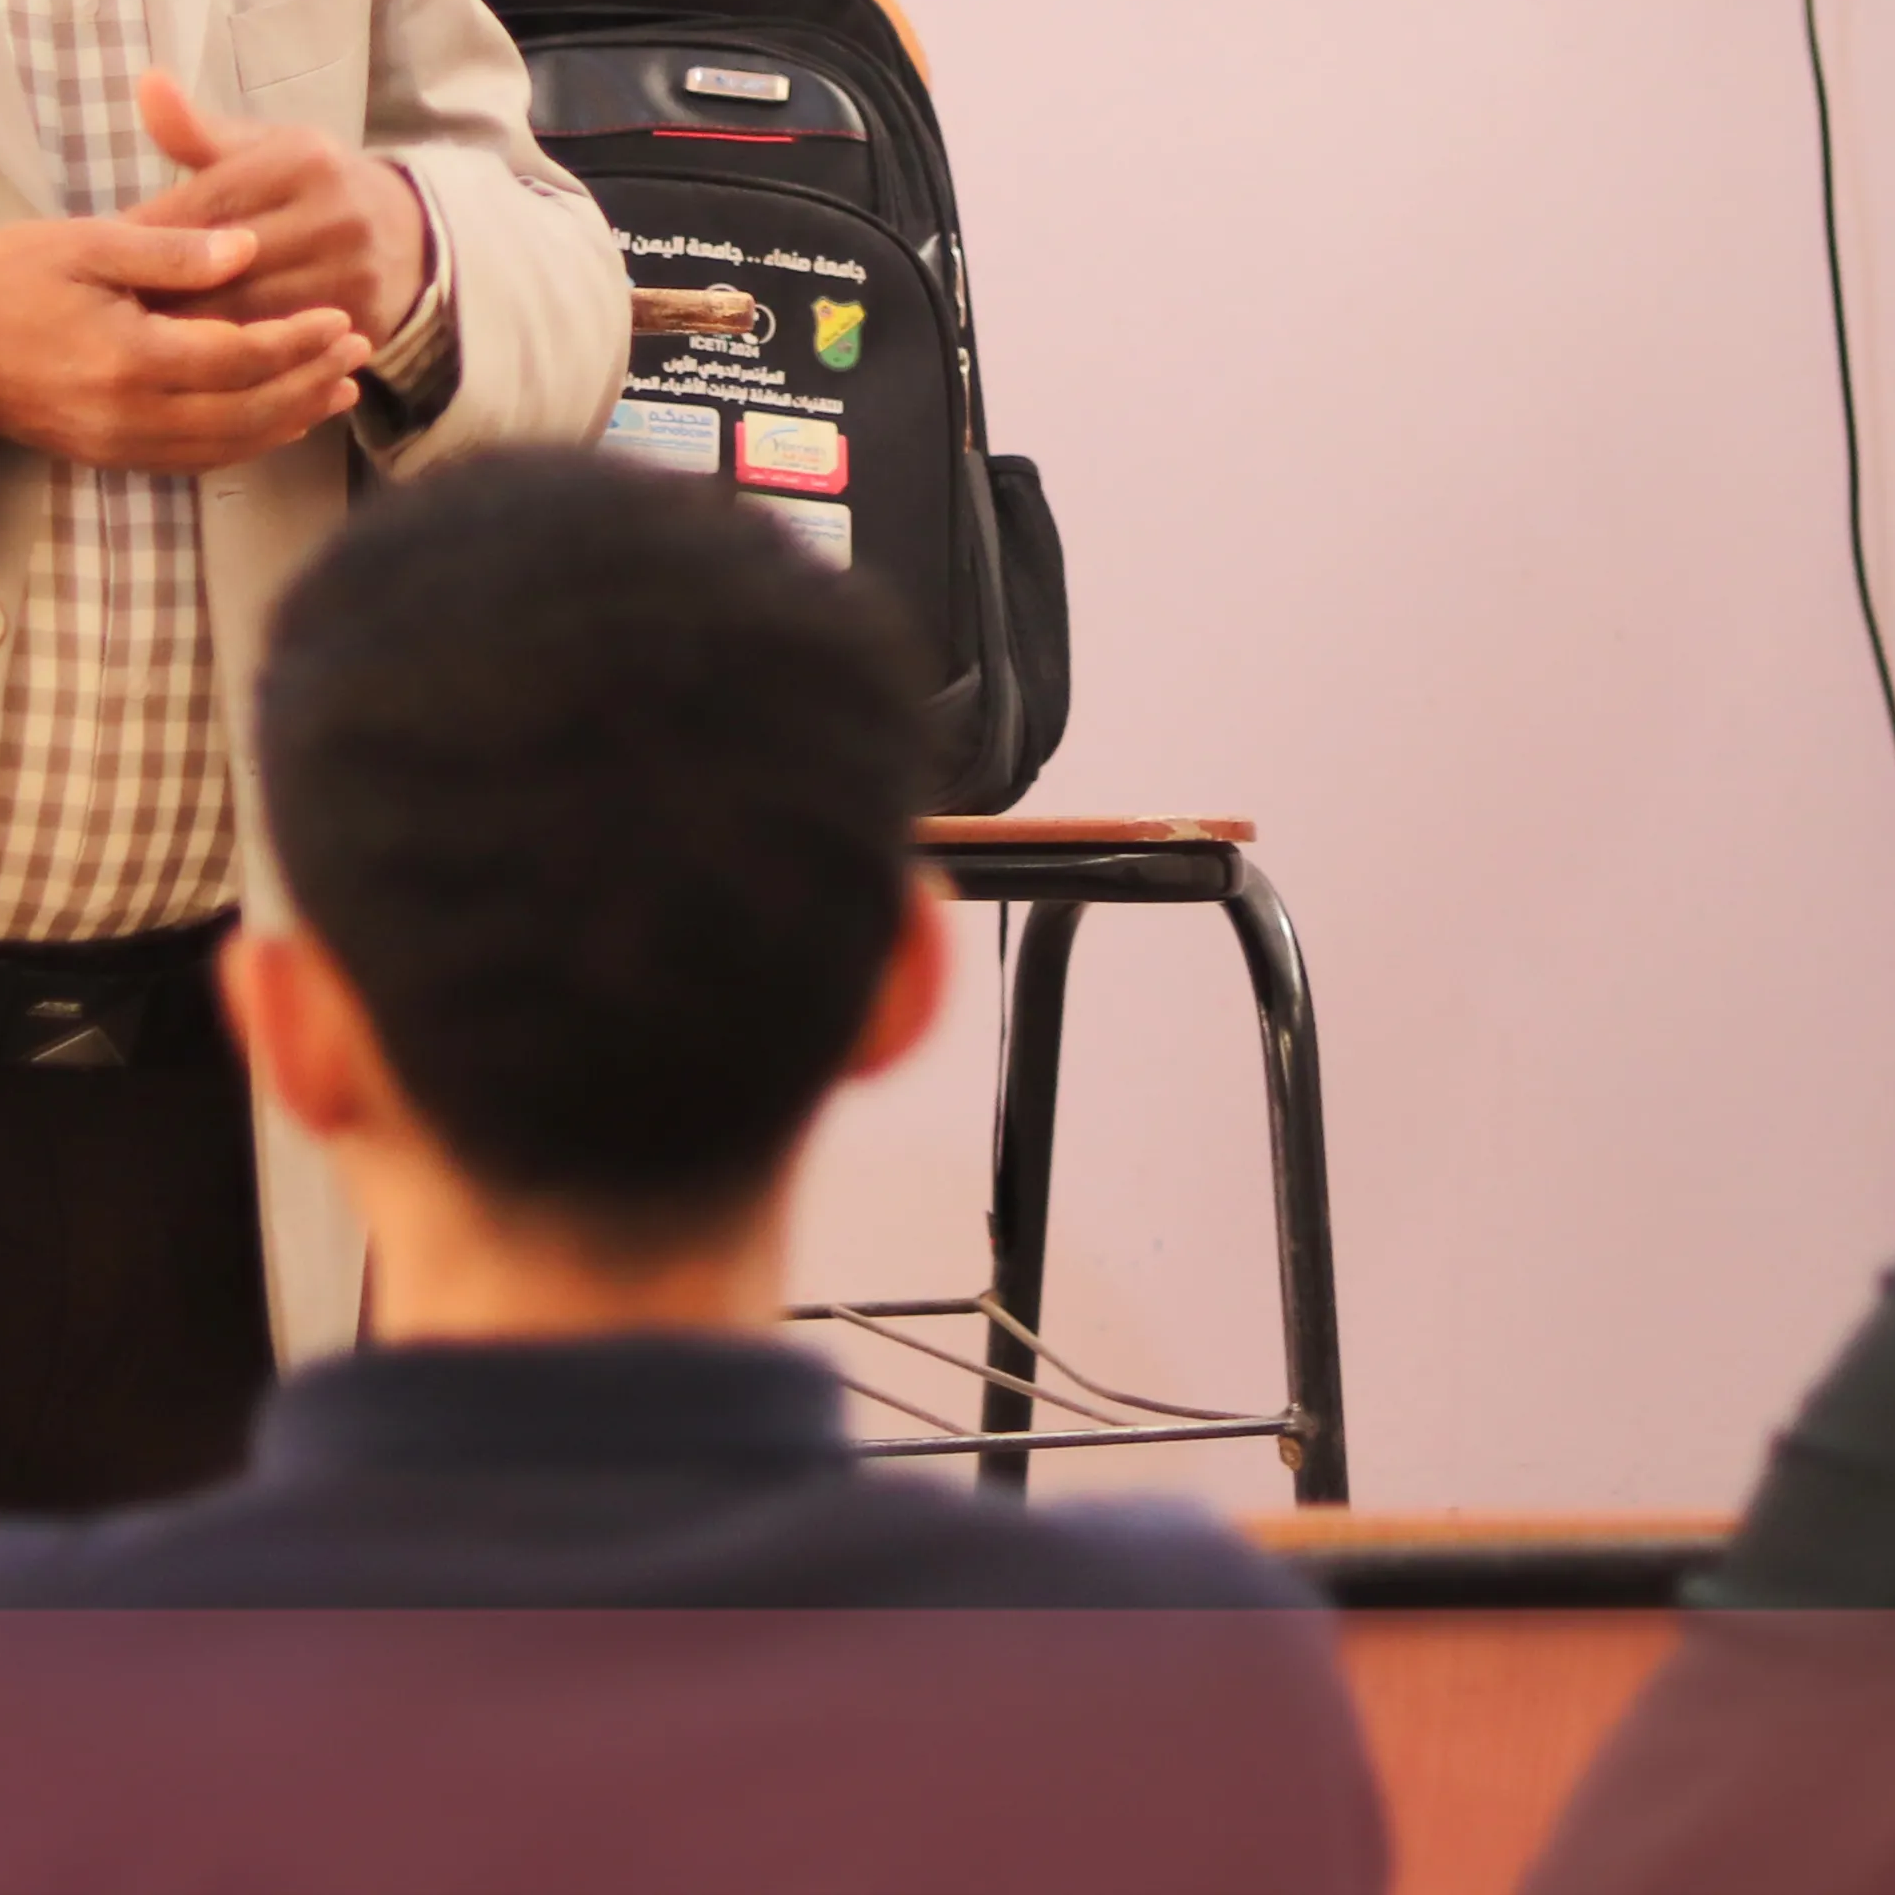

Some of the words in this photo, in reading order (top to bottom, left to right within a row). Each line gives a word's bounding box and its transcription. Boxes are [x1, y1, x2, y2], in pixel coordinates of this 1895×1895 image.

[631, 235, 686, 259] اليمن
[685, 237, 745, 266] جامعة
[762, 248, 812, 273] صنعاء
[812, 255, 867, 284] جامعة
